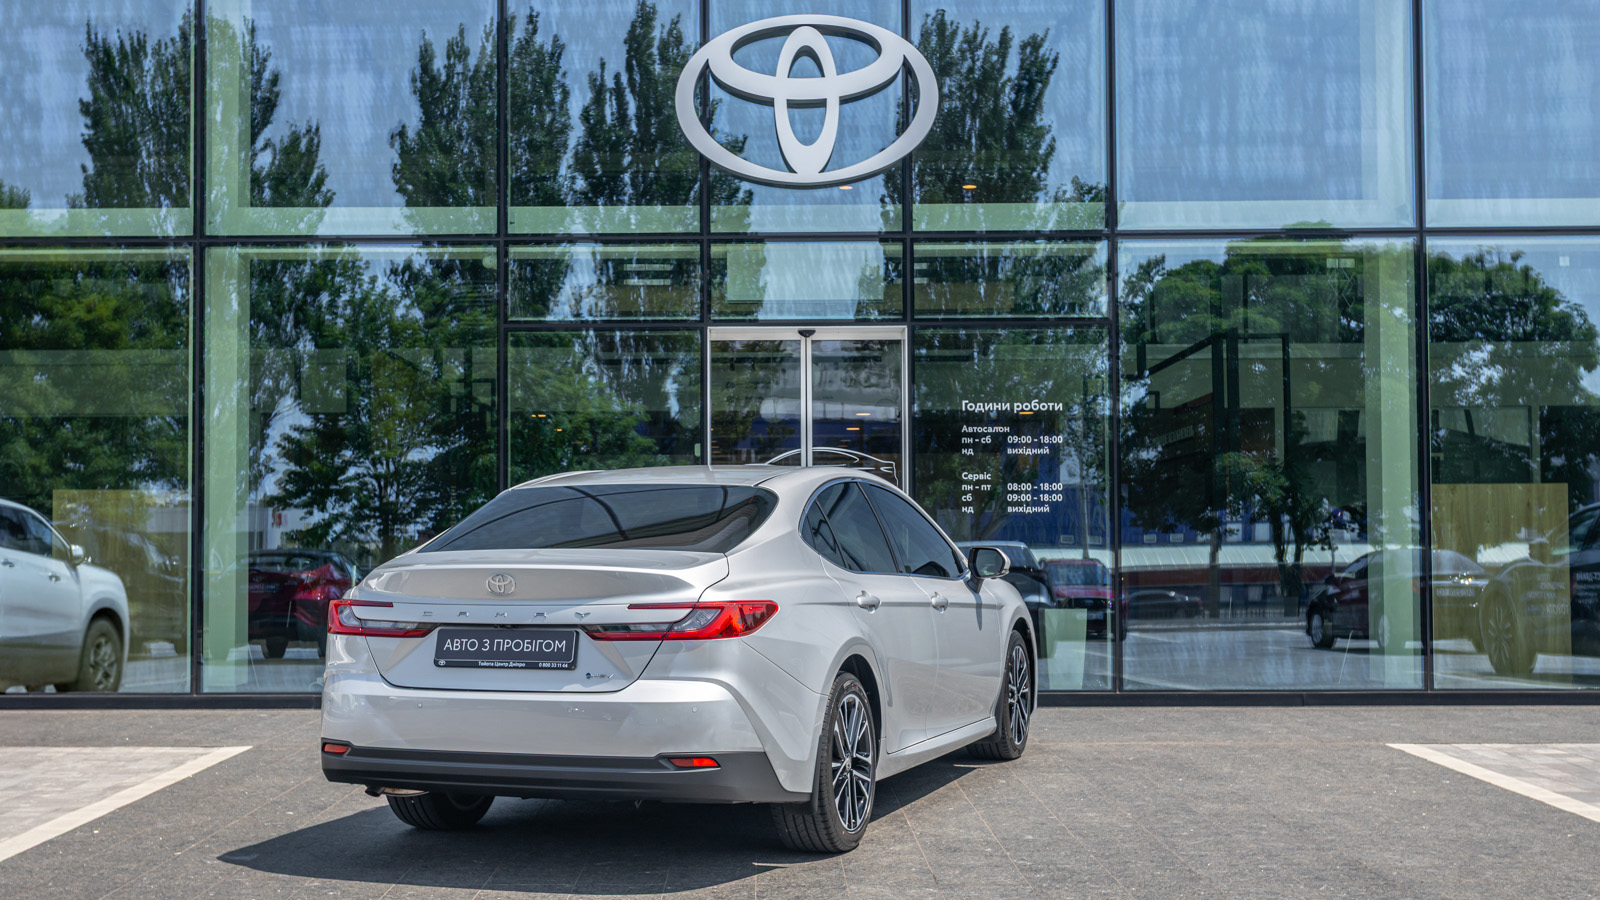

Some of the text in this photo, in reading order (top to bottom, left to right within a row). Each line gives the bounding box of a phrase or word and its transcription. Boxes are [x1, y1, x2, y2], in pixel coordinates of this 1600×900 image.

[961, 399, 1063, 414] Години роботи
[961, 425, 1010, 433] Автосалон
[980, 435, 992, 444] сб
[1007, 435, 1032, 444] 09:00
[1039, 435, 1063, 444] 18:00
[961, 446, 1050, 456] нд вихідний
[961, 471, 992, 481] Сервіс
[1007, 482, 1032, 491] 08:00
[1039, 482, 1063, 491] 18:00
[961, 493, 973, 502] сб
[1006, 493, 1032, 502] 09:00
[1039, 493, 1063, 502] 18:00
[961, 504, 1050, 514] нд вихідний
[443, 638, 479, 651] АВТО
[493, 639, 566, 652] ПРОБІГОМ
